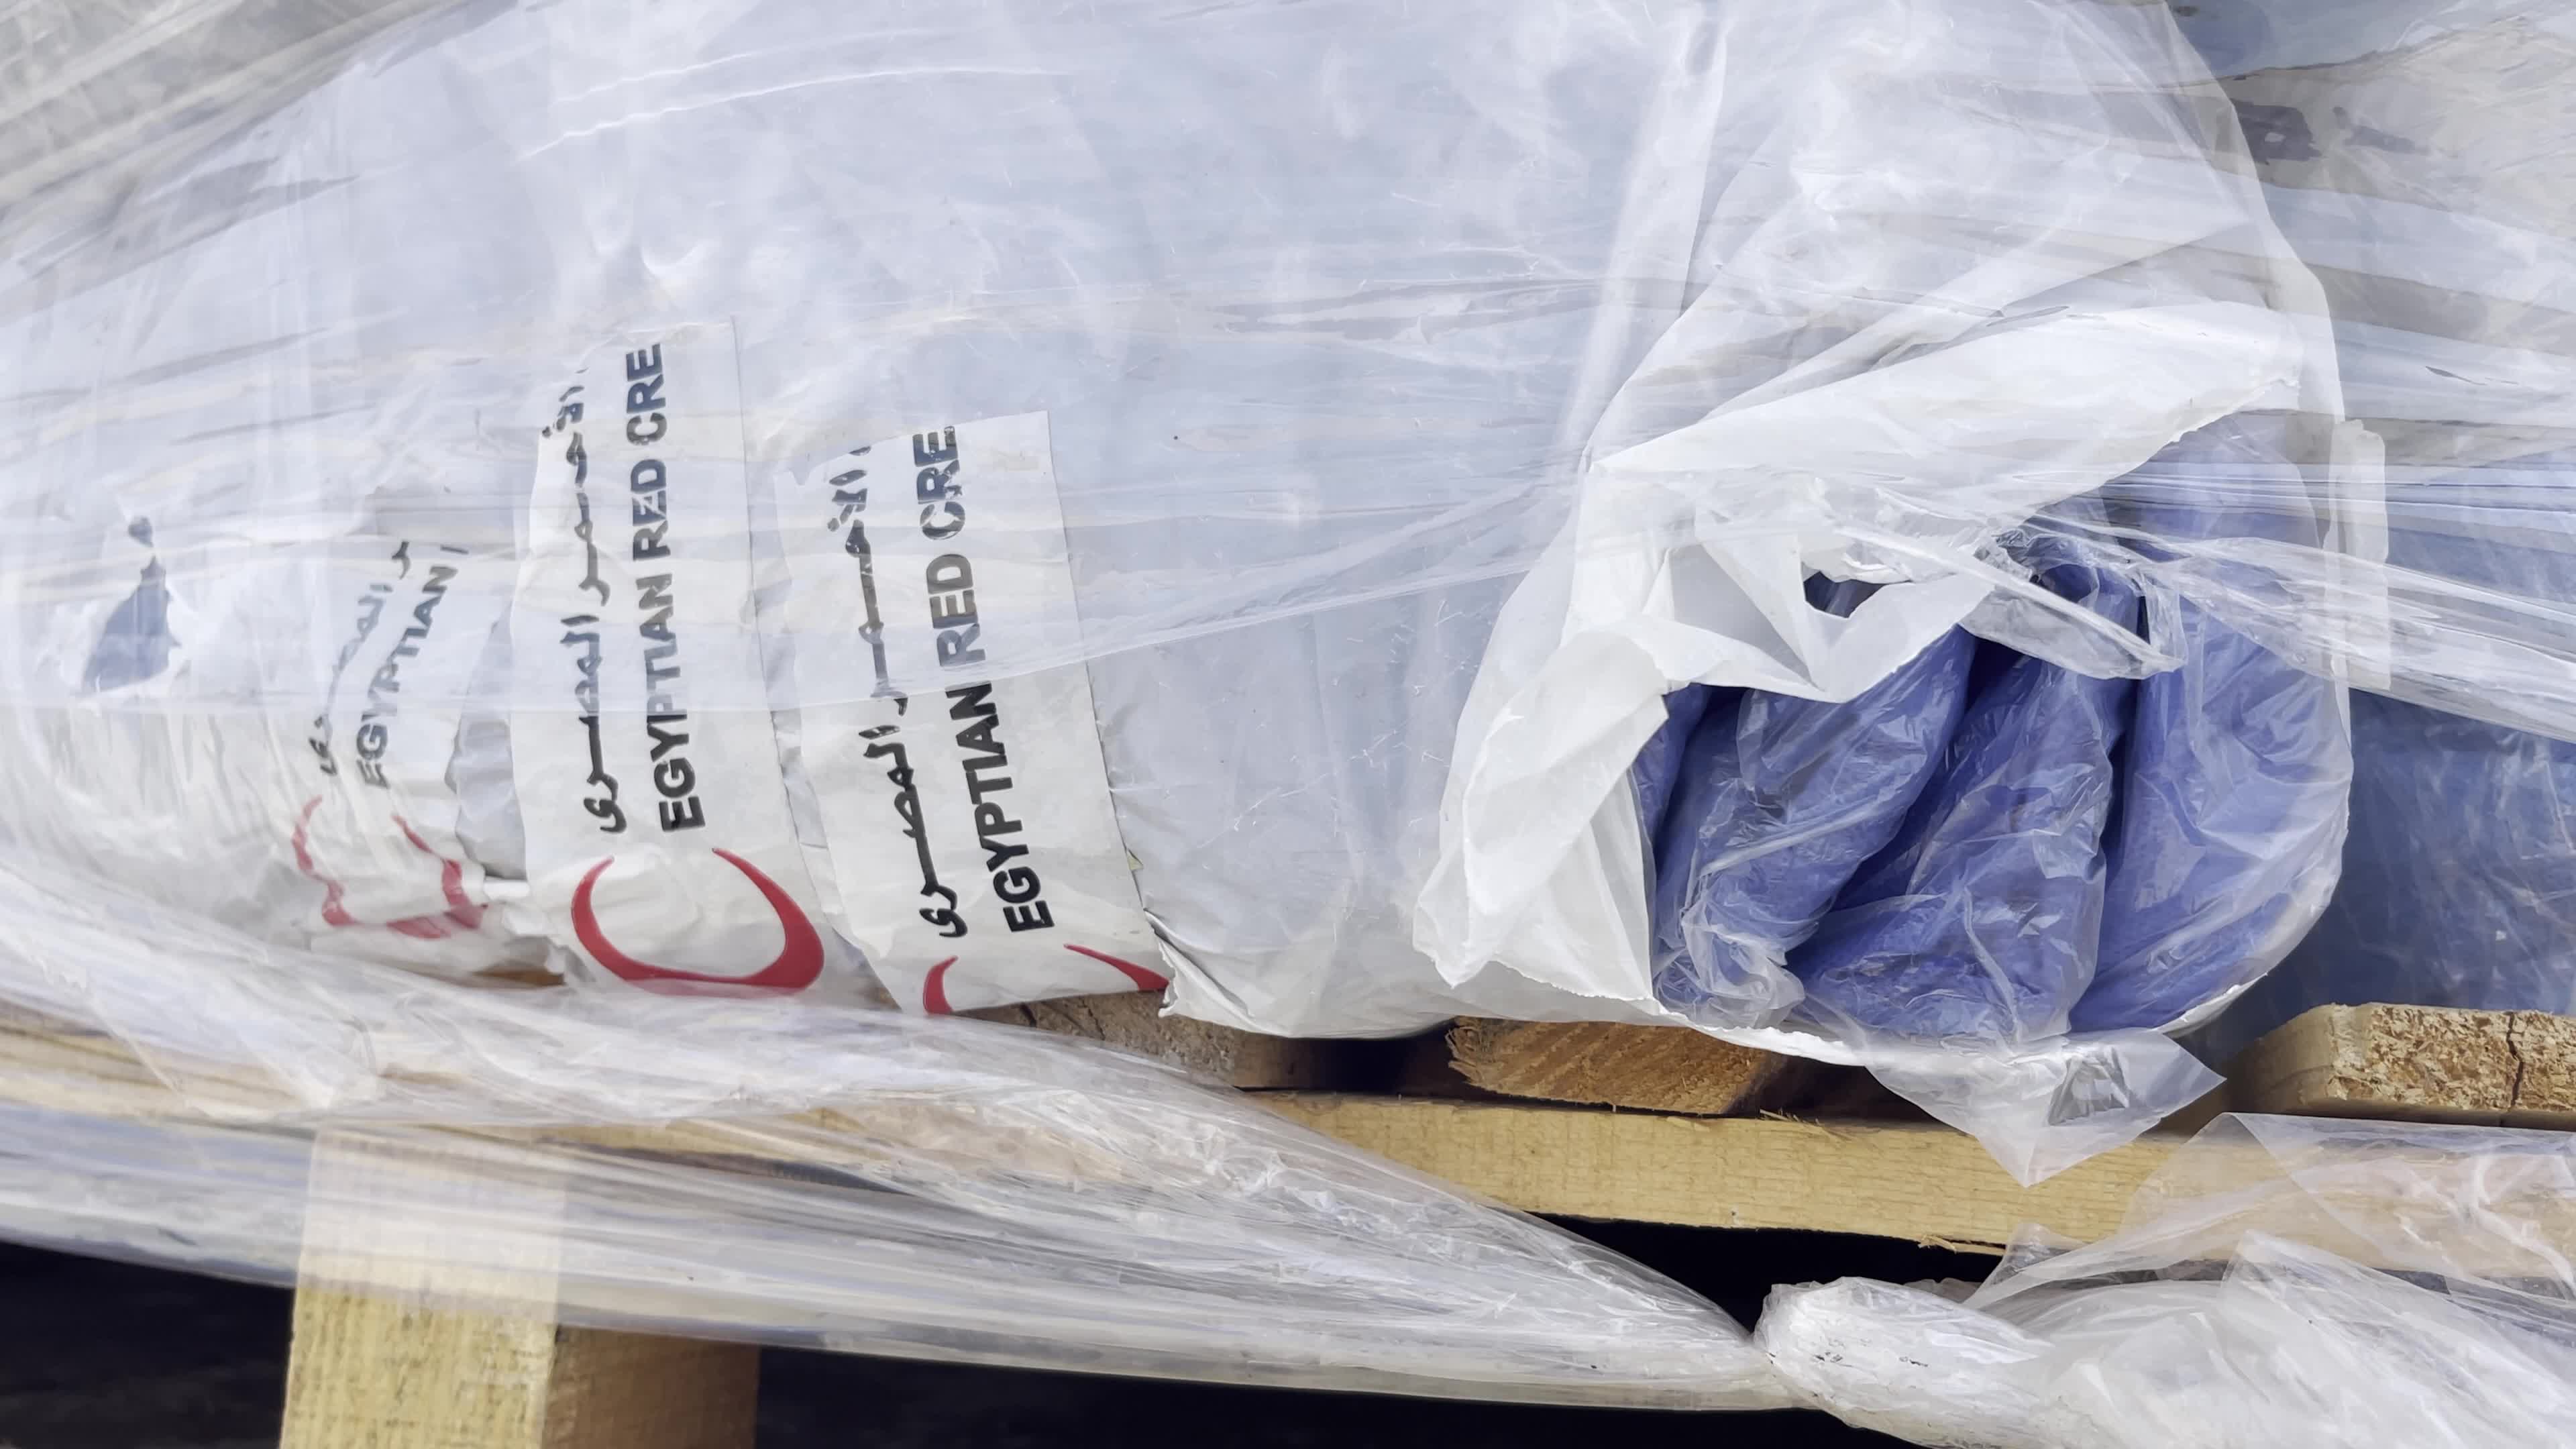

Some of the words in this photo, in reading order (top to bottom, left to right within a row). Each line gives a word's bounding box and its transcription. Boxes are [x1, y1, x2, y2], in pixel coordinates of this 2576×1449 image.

[630, 458, 670, 562] RED
[926, 553, 987, 668] RED
[356, 566, 458, 789] EGYPTIAN
[635, 574, 706, 834] EGYPTIAN
[945, 680, 1056, 933] EGYPTIAN
